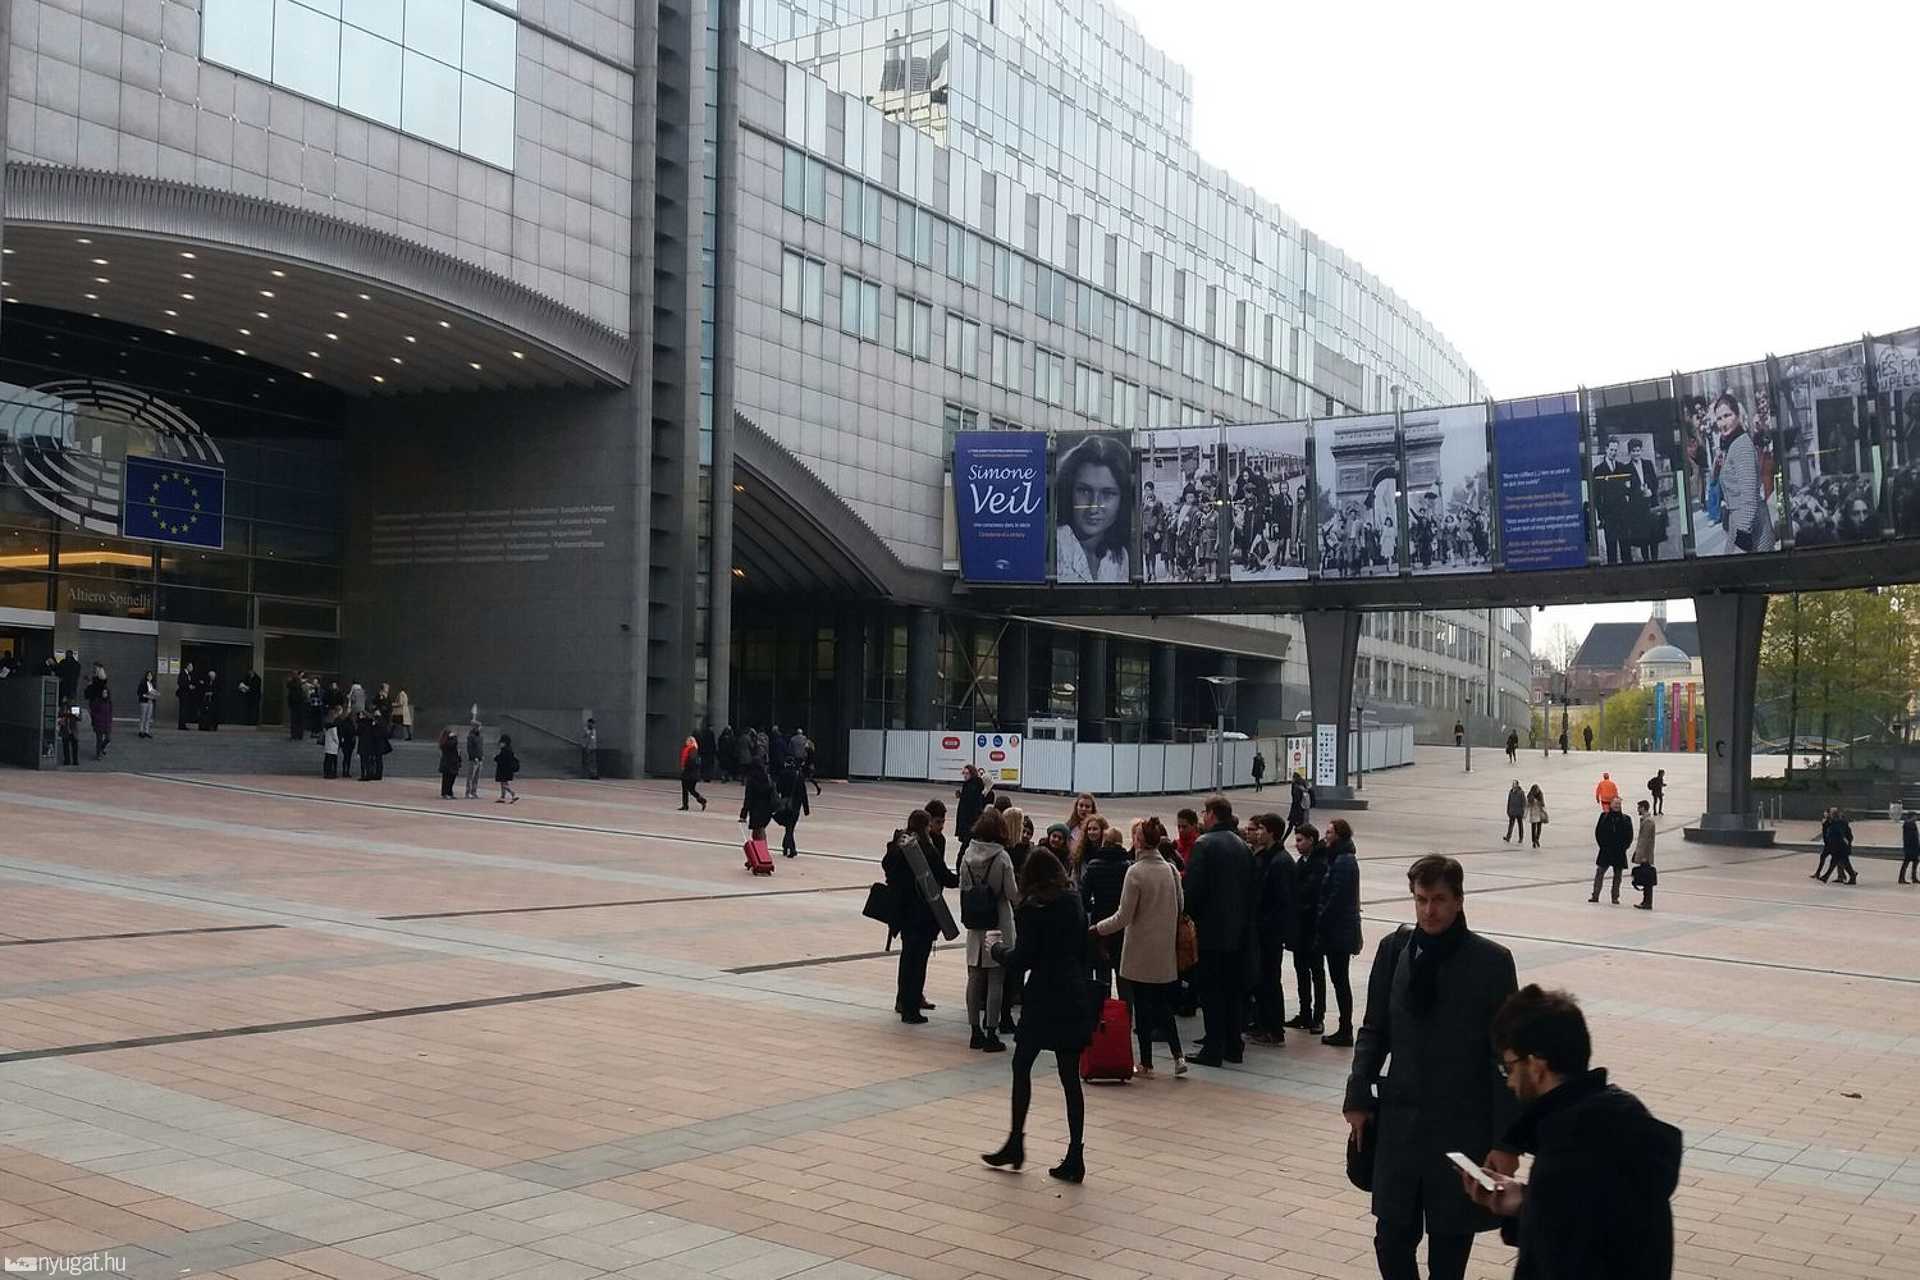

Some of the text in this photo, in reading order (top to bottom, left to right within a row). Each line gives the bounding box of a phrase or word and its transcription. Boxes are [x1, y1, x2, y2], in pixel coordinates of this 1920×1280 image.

[968, 464, 1037, 480] Simone
[969, 481, 1041, 514] Veil
[69, 587, 152, 608] Altiero Spinelli
